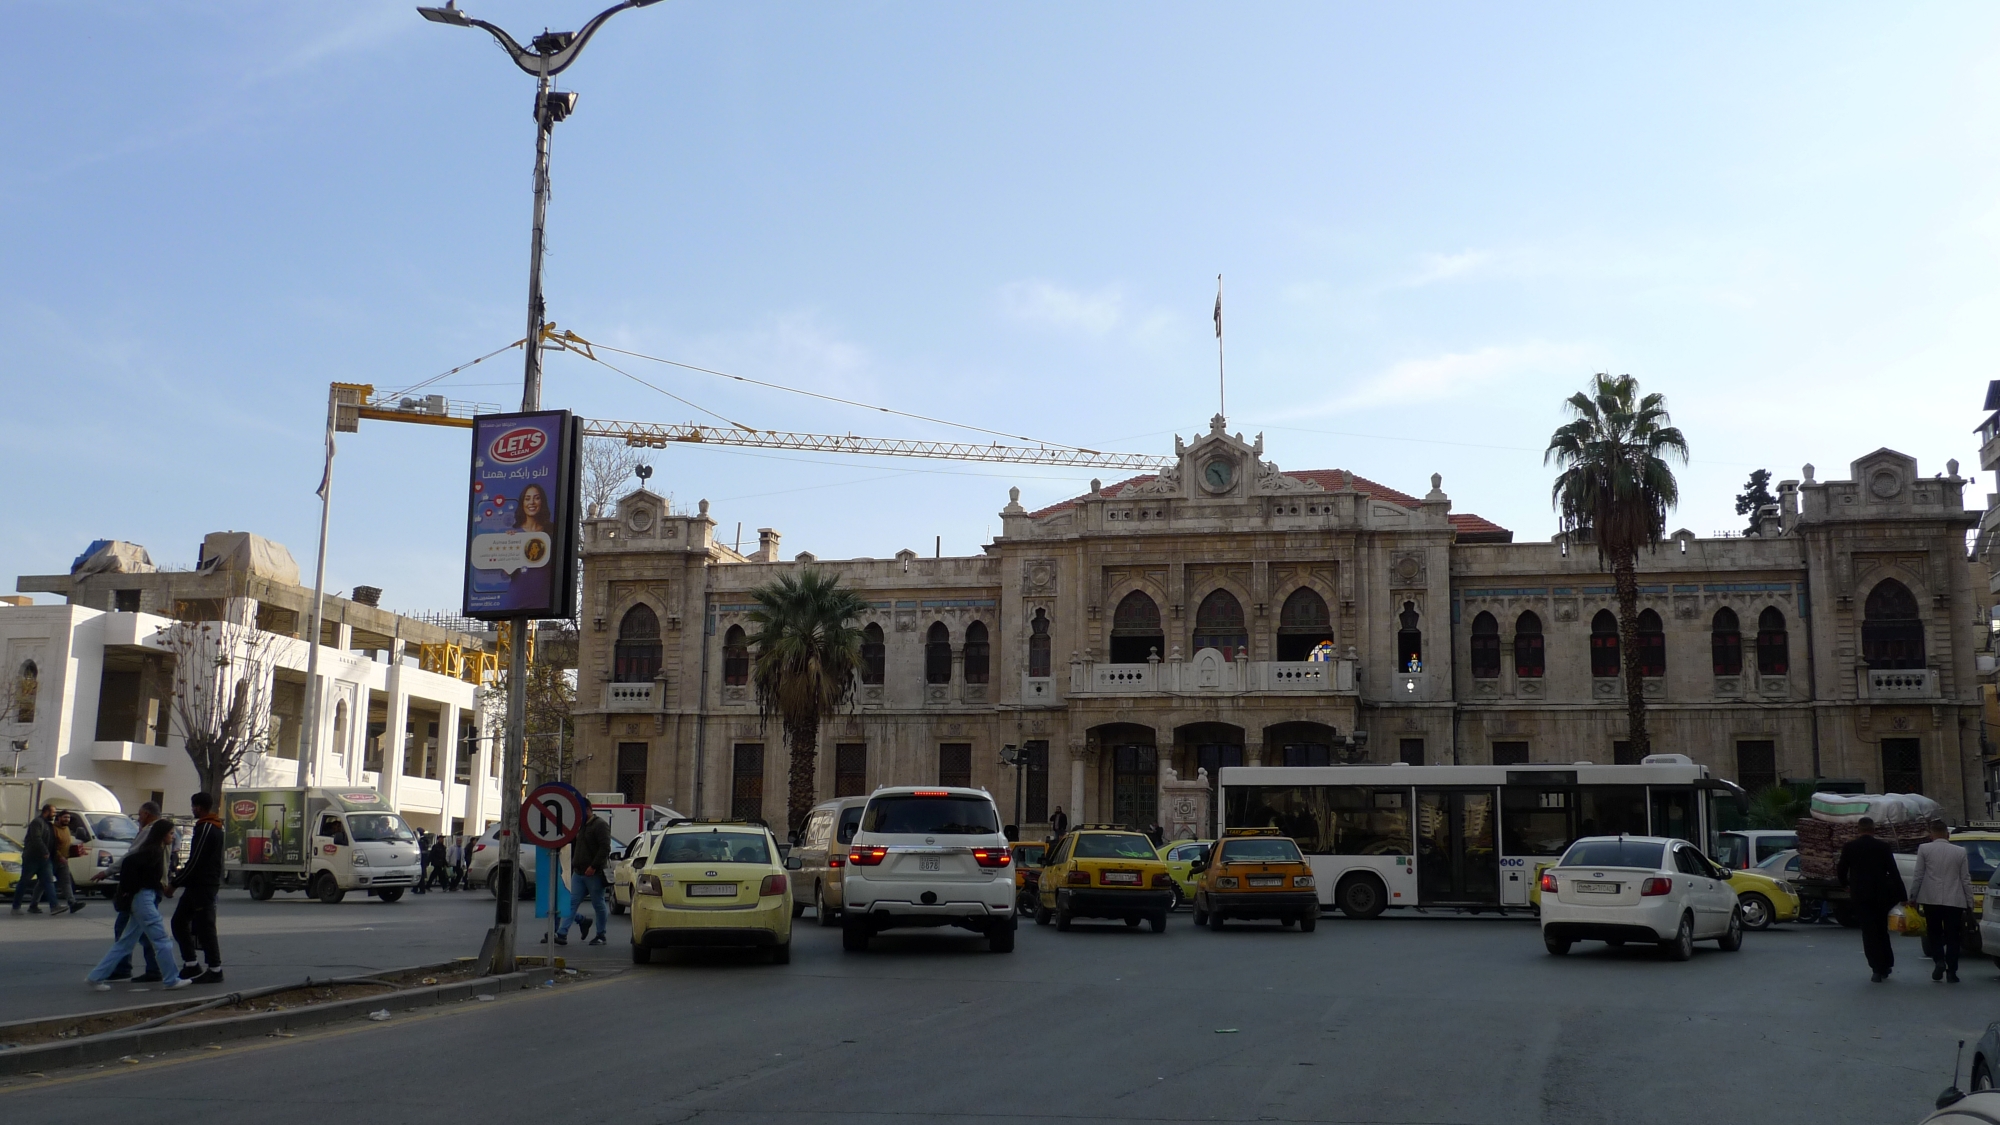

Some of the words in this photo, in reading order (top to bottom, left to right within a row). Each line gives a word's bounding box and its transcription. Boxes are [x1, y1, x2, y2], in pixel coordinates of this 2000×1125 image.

[497, 432, 542, 453] LET'S
[510, 448, 529, 456] CLEAN
[509, 466, 530, 479] رأيكم
[532, 466, 548, 479] لأنو
